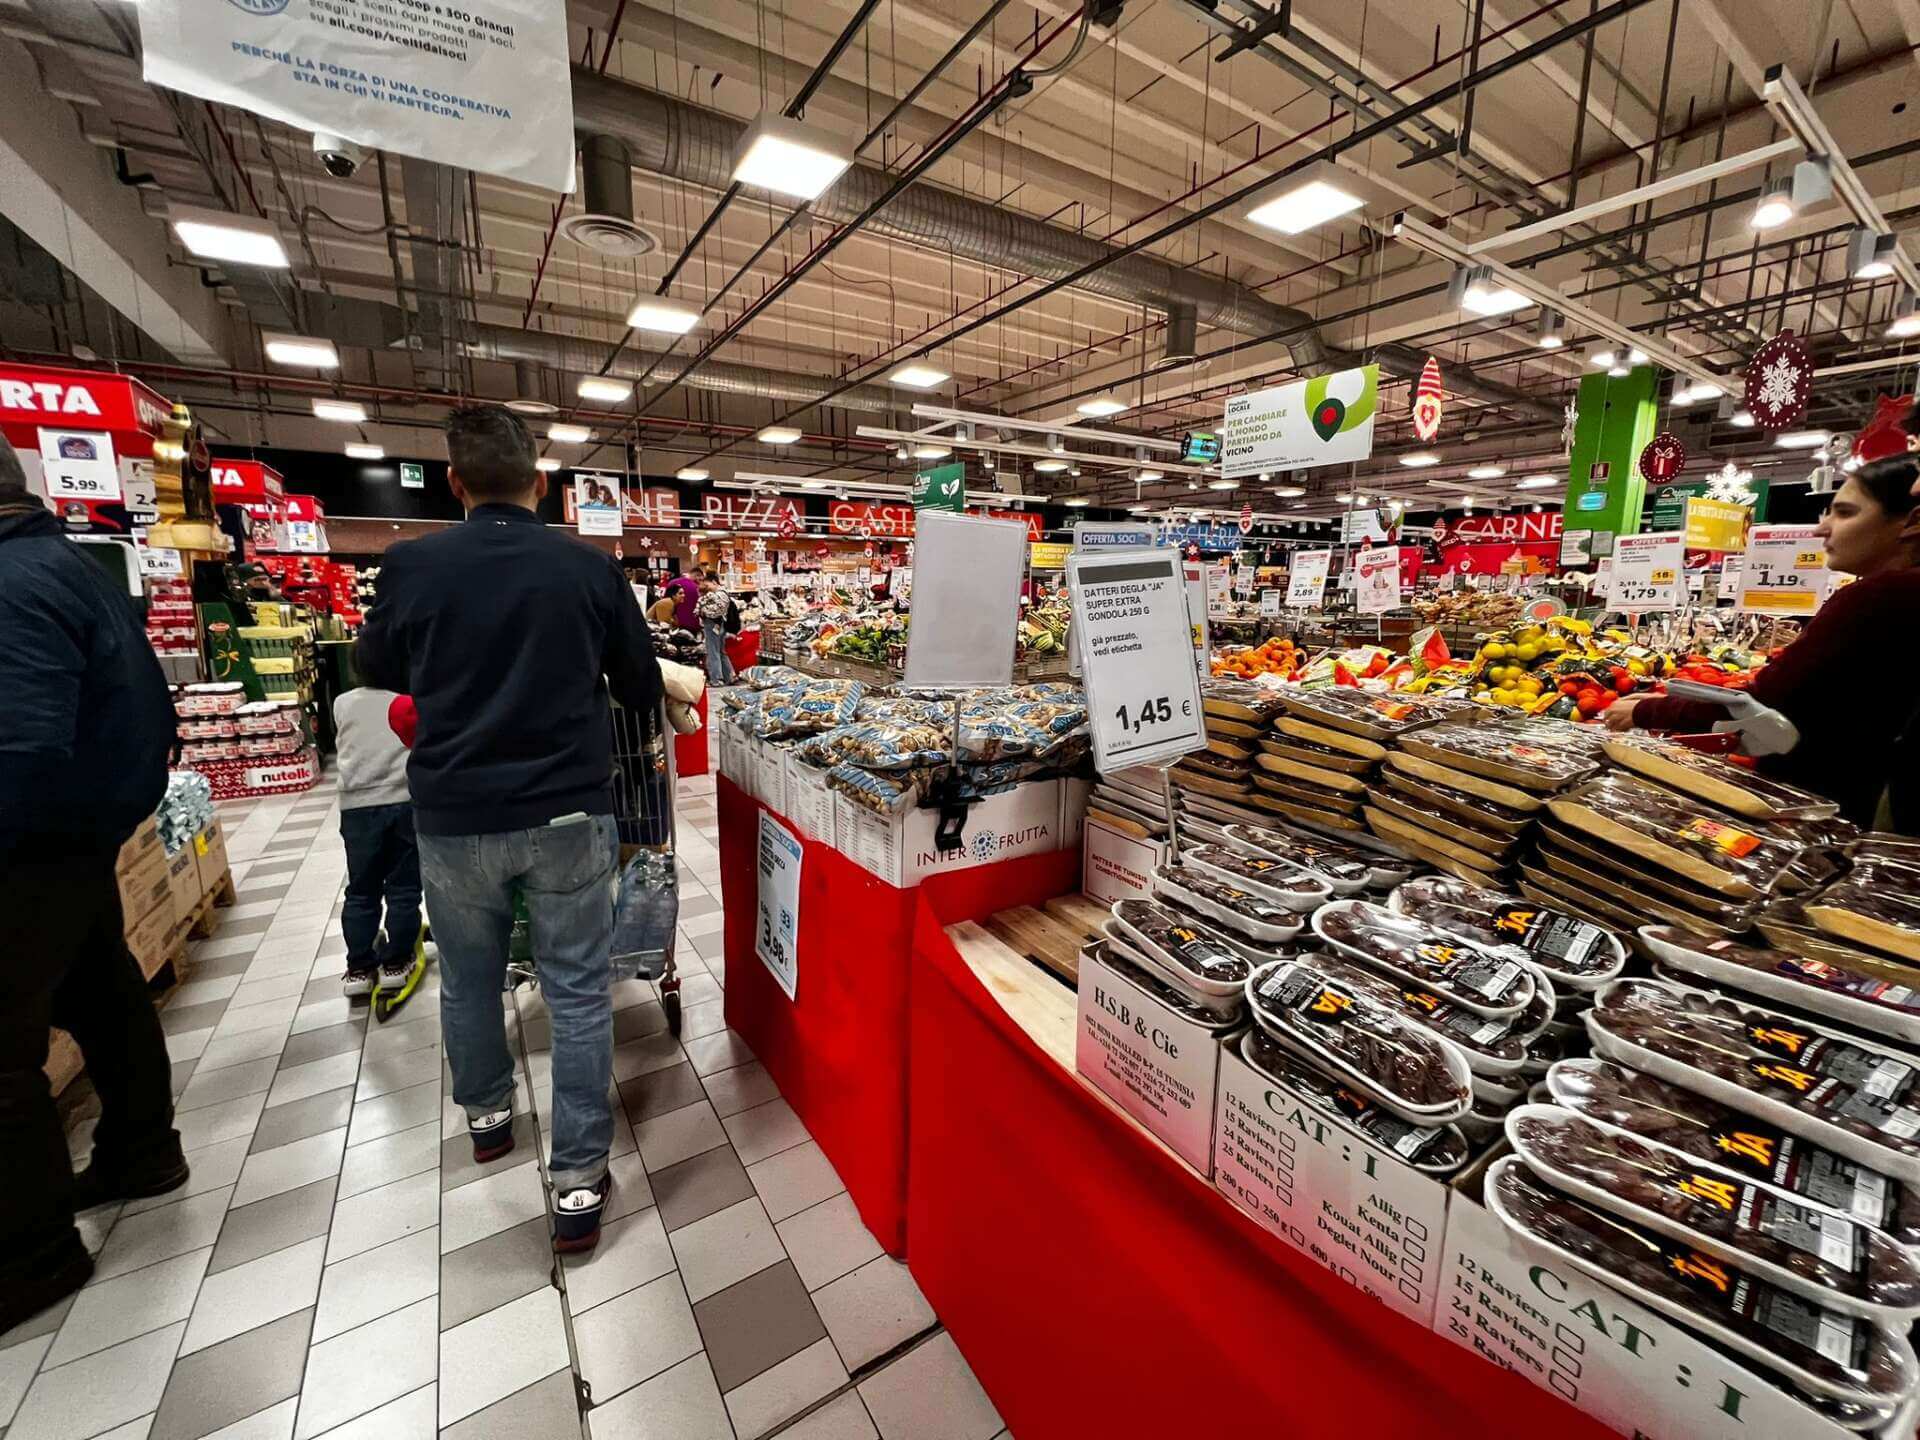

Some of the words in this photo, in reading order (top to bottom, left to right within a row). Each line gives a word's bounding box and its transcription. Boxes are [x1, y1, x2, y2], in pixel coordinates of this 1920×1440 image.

[309, 12, 325, 23] su
[361, 13, 415, 33] prossimi
[418, 28, 468, 48] prodotti
[402, 11, 429, 24] ogni
[433, 18, 465, 35] mese
[468, 28, 486, 41] dai
[489, 36, 516, 50] soci.
[446, 8, 471, 23] 300
[475, 16, 514, 36] Grandi
[293, 71, 321, 86] STA
[324, 78, 340, 90] IN
[344, 83, 367, 96] CHI
[371, 90, 385, 101] VI
[389, 93, 465, 121] PARTECIPA.
[295, 56, 315, 70] LA
[319, 63, 368, 82] FORZA
[372, 76, 386, 87] DI
[389, 80, 418, 96] UNA
[422, 88, 512, 120] COOPERATIVA
[1227, 418, 1244, 429] PER
[1243, 408, 1288, 425] CAMBIARE
[1228, 403, 1252, 414] LOCALE
[1226, 434, 1269, 448] PARTIAMO
[1269, 431, 1283, 440] DA
[1227, 430, 1235, 439] IL
[1236, 424, 1268, 437] MONDO
[1226, 446, 1254, 457] VICINO
[60, 475, 98, 491] 5,99
[706, 495, 800, 529] PIZZA
[1456, 513, 1564, 540] CARNE
[1082, 534, 1116, 544] OFFERTA
[1117, 534, 1137, 544] SOCI
[1083, 586, 1120, 599] DATTERI
[1120, 584, 1147, 594] DEGLA
[1147, 582, 1165, 592] "JA"
[1622, 588, 1657, 600] 1,79
[1757, 571, 1799, 588] 1,19
[1086, 598, 1114, 610] SUPER
[1115, 596, 1142, 607] EXTRA
[1087, 609, 1128, 622] GONDOLA
[1129, 606, 1142, 617] 250
[1143, 606, 1150, 615] G
[1093, 647, 1110, 657] vedi
[1111, 643, 1143, 655] etichetta
[1115, 697, 1173, 734] 1,45
[1181, 699, 1192, 718] €
[999, 825, 1049, 850] FRUTTA
[1502, 911, 1536, 935] JA
[763, 919, 784, 966] 3,98
[1094, 986, 1131, 1026] H.S.B
[1134, 1016, 1148, 1039] &
[1152, 1028, 1179, 1060] Cie
[1765, 1028, 1809, 1053] JA
[1157, 1079, 1166, 1092] 72
[1166, 1086, 1178, 1101] 252
[1162, 1070, 1196, 1101] TUNISIA
[1770, 1066, 1817, 1091] JA
[1225, 1091, 1237, 1107] 12
[1238, 1101, 1277, 1137] Raviers
[1223, 1125, 1235, 1141] 24
[1236, 1135, 1275, 1172] Raviers
[1225, 1108, 1236, 1123] 15
[1238, 1117, 1276, 1155] Raviers
[1263, 1090, 1332, 1147] CAT
[1340, 1144, 1352, 1162] :
[1362, 1151, 1380, 1181] I
[1222, 1142, 1234, 1157] 25
[1236, 1153, 1274, 1190] Raviers
[1726, 1131, 1775, 1167] JA
[1367, 1193, 1402, 1225] Allig
[1690, 1174, 1738, 1211] JA
[1221, 1171, 1237, 1189] 200
[1263, 1204, 1280, 1224] 250
[1309, 1243, 1328, 1263] 400
[1329, 1261, 1337, 1274] g
[1322, 1199, 1361, 1237] Kouat
[1363, 1233, 1398, 1266] Allig
[1357, 1204, 1400, 1243] Kenta
[1316, 1215, 1358, 1254] Deglet
[1360, 1247, 1397, 1282] Nour
[1457, 1252, 1477, 1275] 12
[1481, 1267, 1550, 1328] Raviers
[1456, 1274, 1475, 1296] 15
[1478, 1291, 1548, 1351] Raviers
[1448, 1316, 1469, 1339] 25
[1473, 1335, 1514, 1372] Ravi
[1451, 1296, 1472, 1318] 24
[1475, 1312, 1544, 1373] Raviers
[1528, 1265, 1656, 1359] CAT
[1675, 1363, 1692, 1388] :
[1715, 1378, 1750, 1424] I
